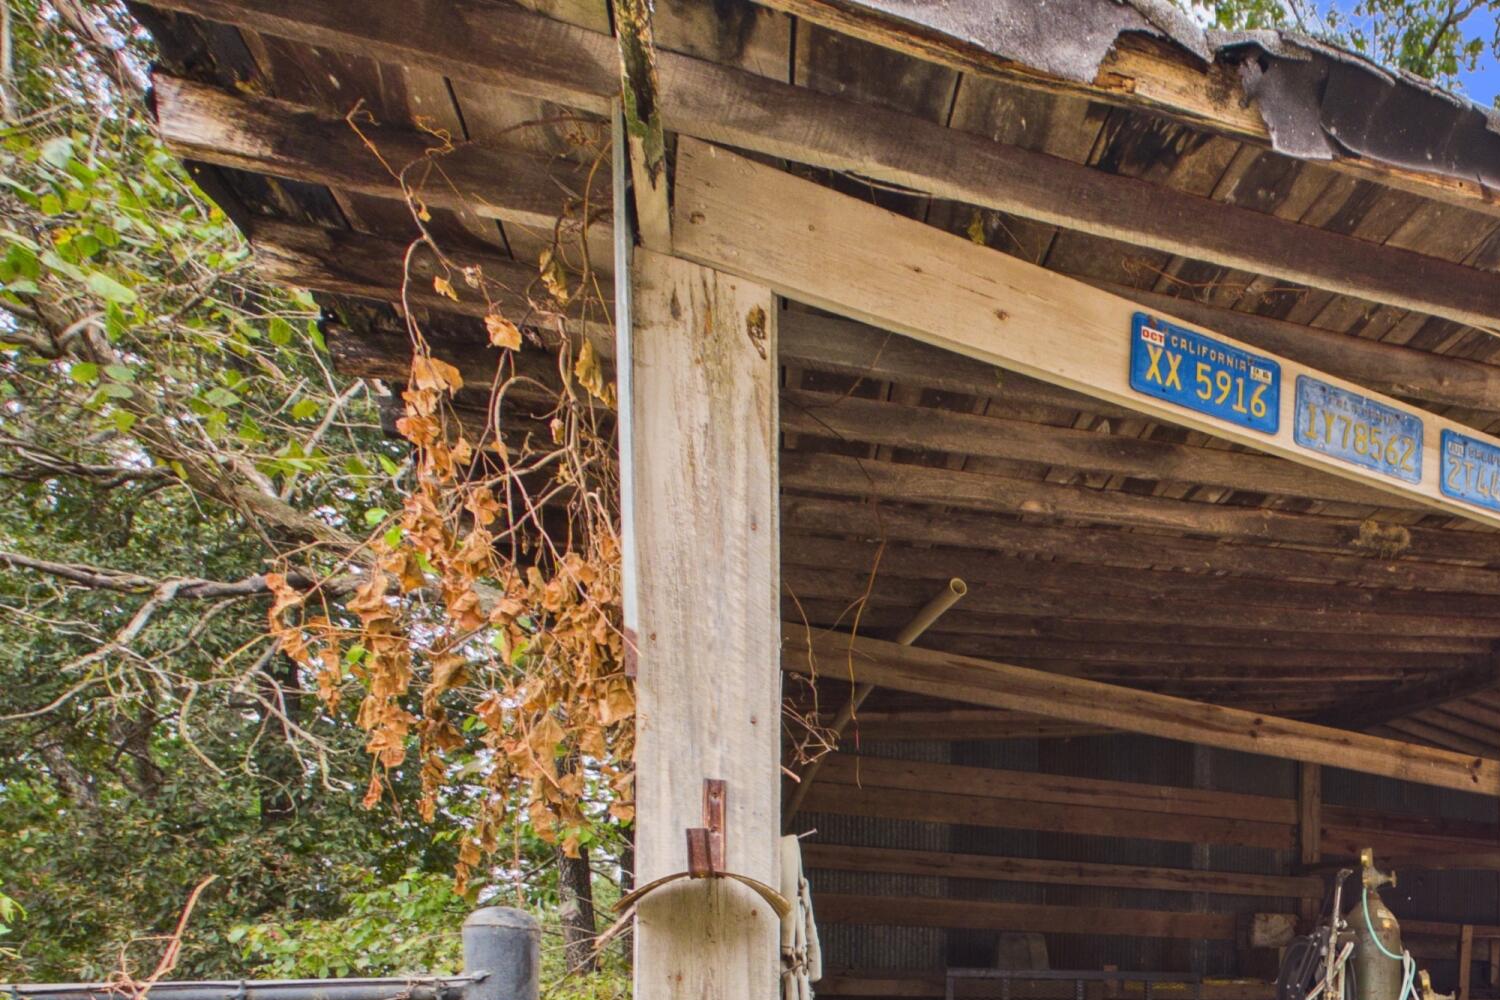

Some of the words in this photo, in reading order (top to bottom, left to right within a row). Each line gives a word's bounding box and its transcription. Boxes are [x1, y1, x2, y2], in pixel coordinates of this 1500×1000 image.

[1142, 328, 1164, 342] OCT
[1170, 336, 1246, 371] CALIFORNIA
[1145, 344, 1182, 391] XX
[1196, 361, 1268, 418] 5916
[1304, 401, 1416, 473] 1Y78562
